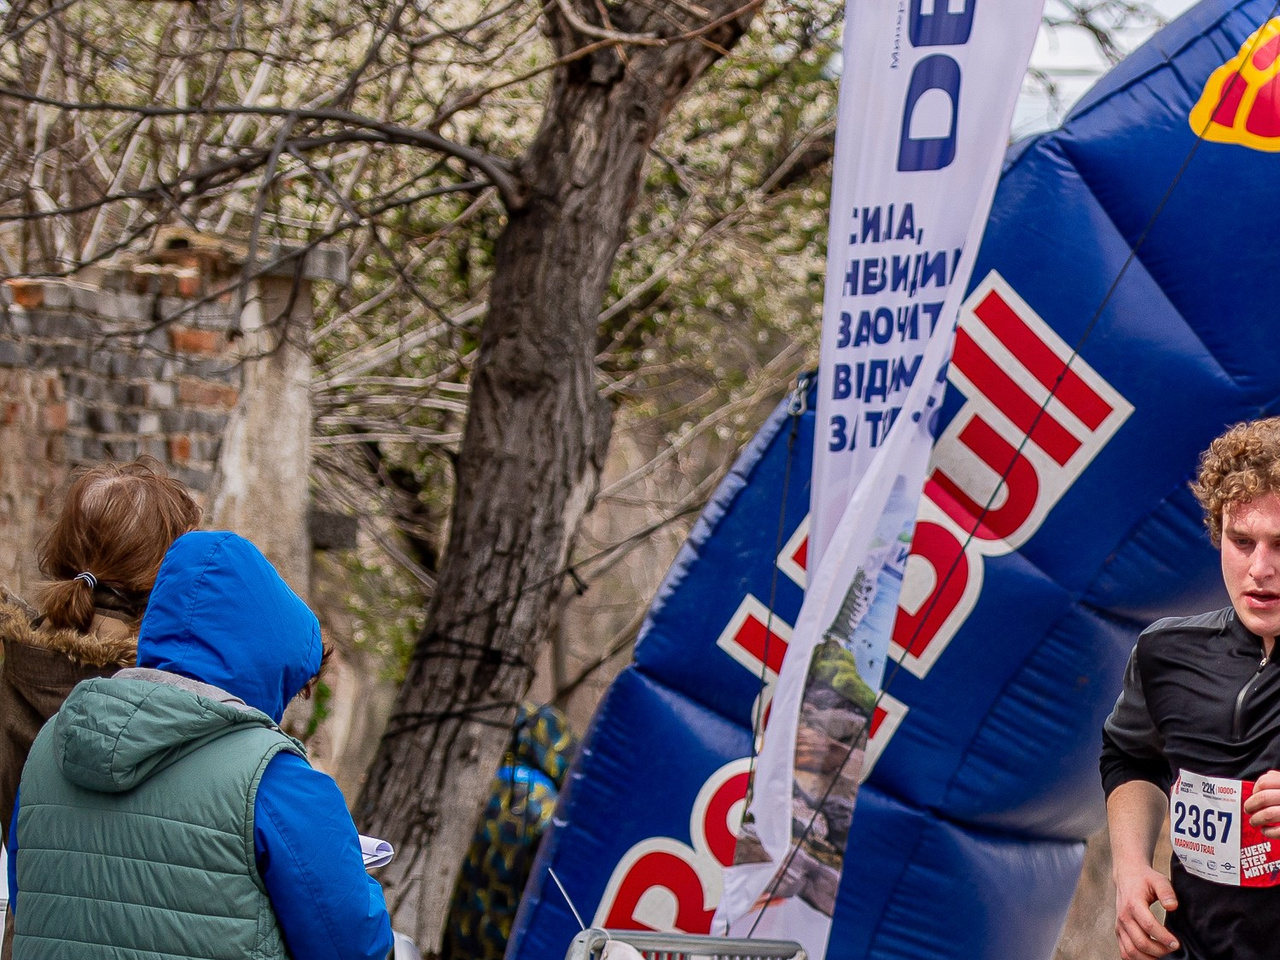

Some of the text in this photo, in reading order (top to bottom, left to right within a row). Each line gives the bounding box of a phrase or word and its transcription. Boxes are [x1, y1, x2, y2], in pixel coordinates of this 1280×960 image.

[892, 278, 1126, 670] Bull
[1202, 781, 1216, 795] 22K
[1174, 801, 1233, 843] 2367
[1174, 837, 1216, 856] MARKOVO TRAIL
[1240, 842, 1272, 858] EVERY
[1241, 854, 1267, 868] STEP
